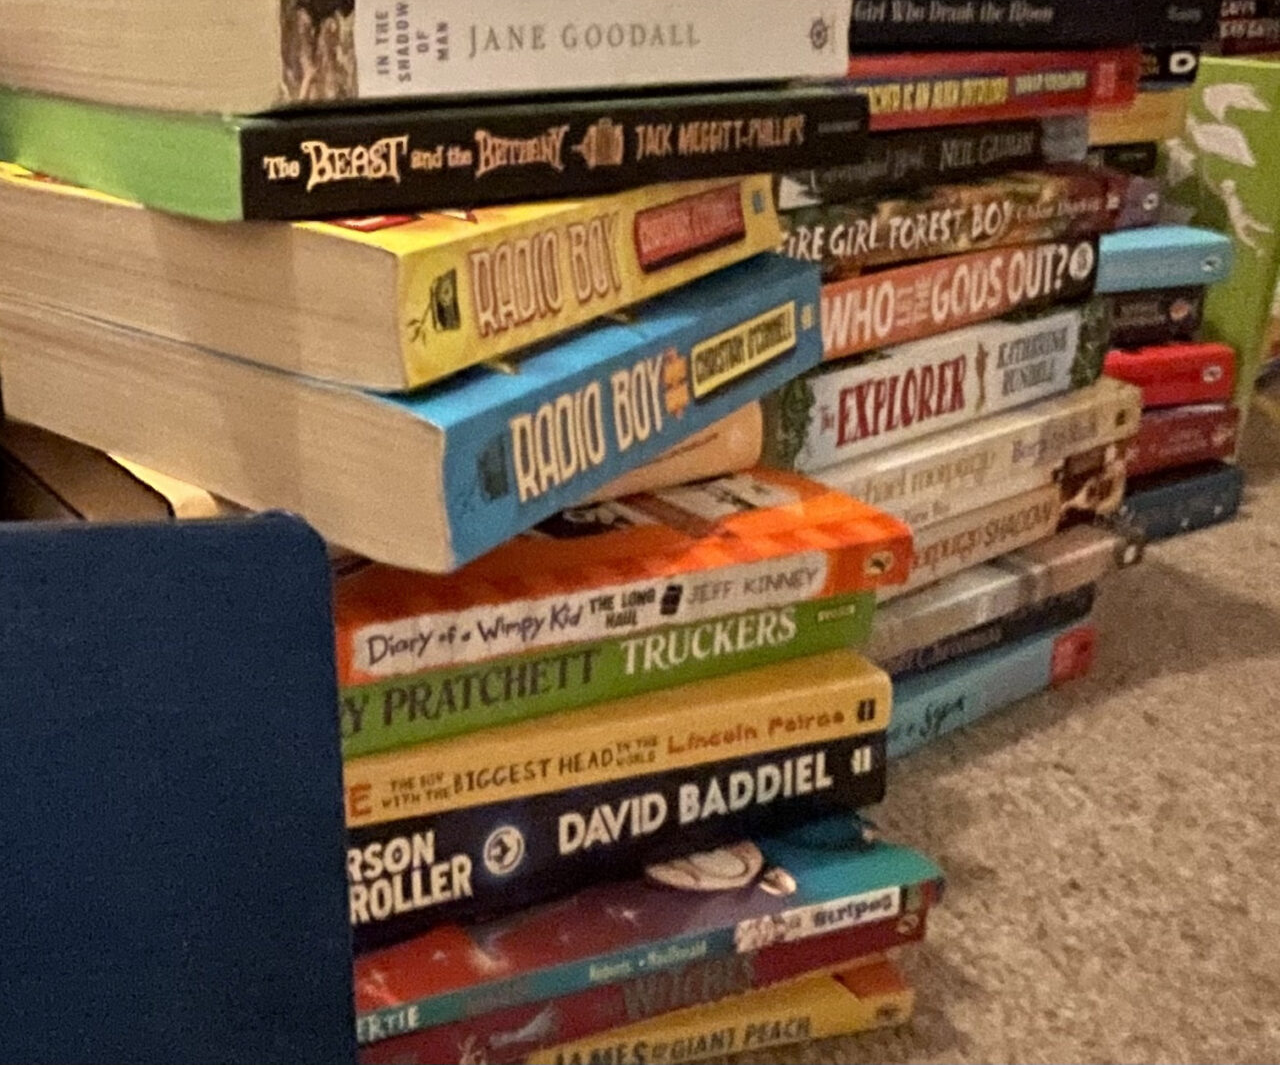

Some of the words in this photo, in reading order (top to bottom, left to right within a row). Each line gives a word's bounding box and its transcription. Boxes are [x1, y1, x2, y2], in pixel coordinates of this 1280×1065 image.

[375, 10, 389, 46] THE
[395, 1, 412, 84] SHADOW
[416, 30, 430, 54] OF
[436, 21, 450, 62] MAN
[468, 24, 547, 59] JANE
[560, 21, 701, 51] GOODALL
[376, 54, 390, 76] IN
[263, 155, 301, 181] The
[301, 134, 410, 193] BEAST
[410, 144, 444, 171] and
[446, 145, 472, 169] the
[635, 123, 673, 162] JACK
[829, 219, 880, 259] GIRL
[890, 209, 967, 252] FOREST
[971, 199, 1012, 238] BOY
[468, 231, 563, 339] RADIO
[570, 207, 622, 307] BOY
[821, 282, 895, 354] WHO
[930, 257, 1003, 325] GODS
[1007, 243, 1068, 303] OUT?
[835, 353, 967, 448] EXPLORER
[508, 380, 607, 503] RADIO
[609, 353, 665, 453] BOY
[589, 594, 615, 615] THE
[621, 587, 656, 608] LONG
[688, 579, 732, 606] JEFF
[742, 565, 819, 595] KINNEY
[366, 630, 433, 667] Diary
[438, 626, 458, 646] of
[461, 630, 472, 643] a
[476, 613, 546, 643] Wimpy
[549, 602, 585, 632] Kid
[382, 647, 603, 727] PRATCHETT
[620, 605, 798, 676] TRUCKERS
[666, 723, 758, 756] Lincoln
[452, 757, 553, 795] BIGGEST
[557, 746, 615, 777] HEAD
[381, 793, 420, 809] WITH
[426, 786, 452, 802] THE
[557, 792, 668, 856] DAVID
[678, 751, 835, 826] BADDIEL
